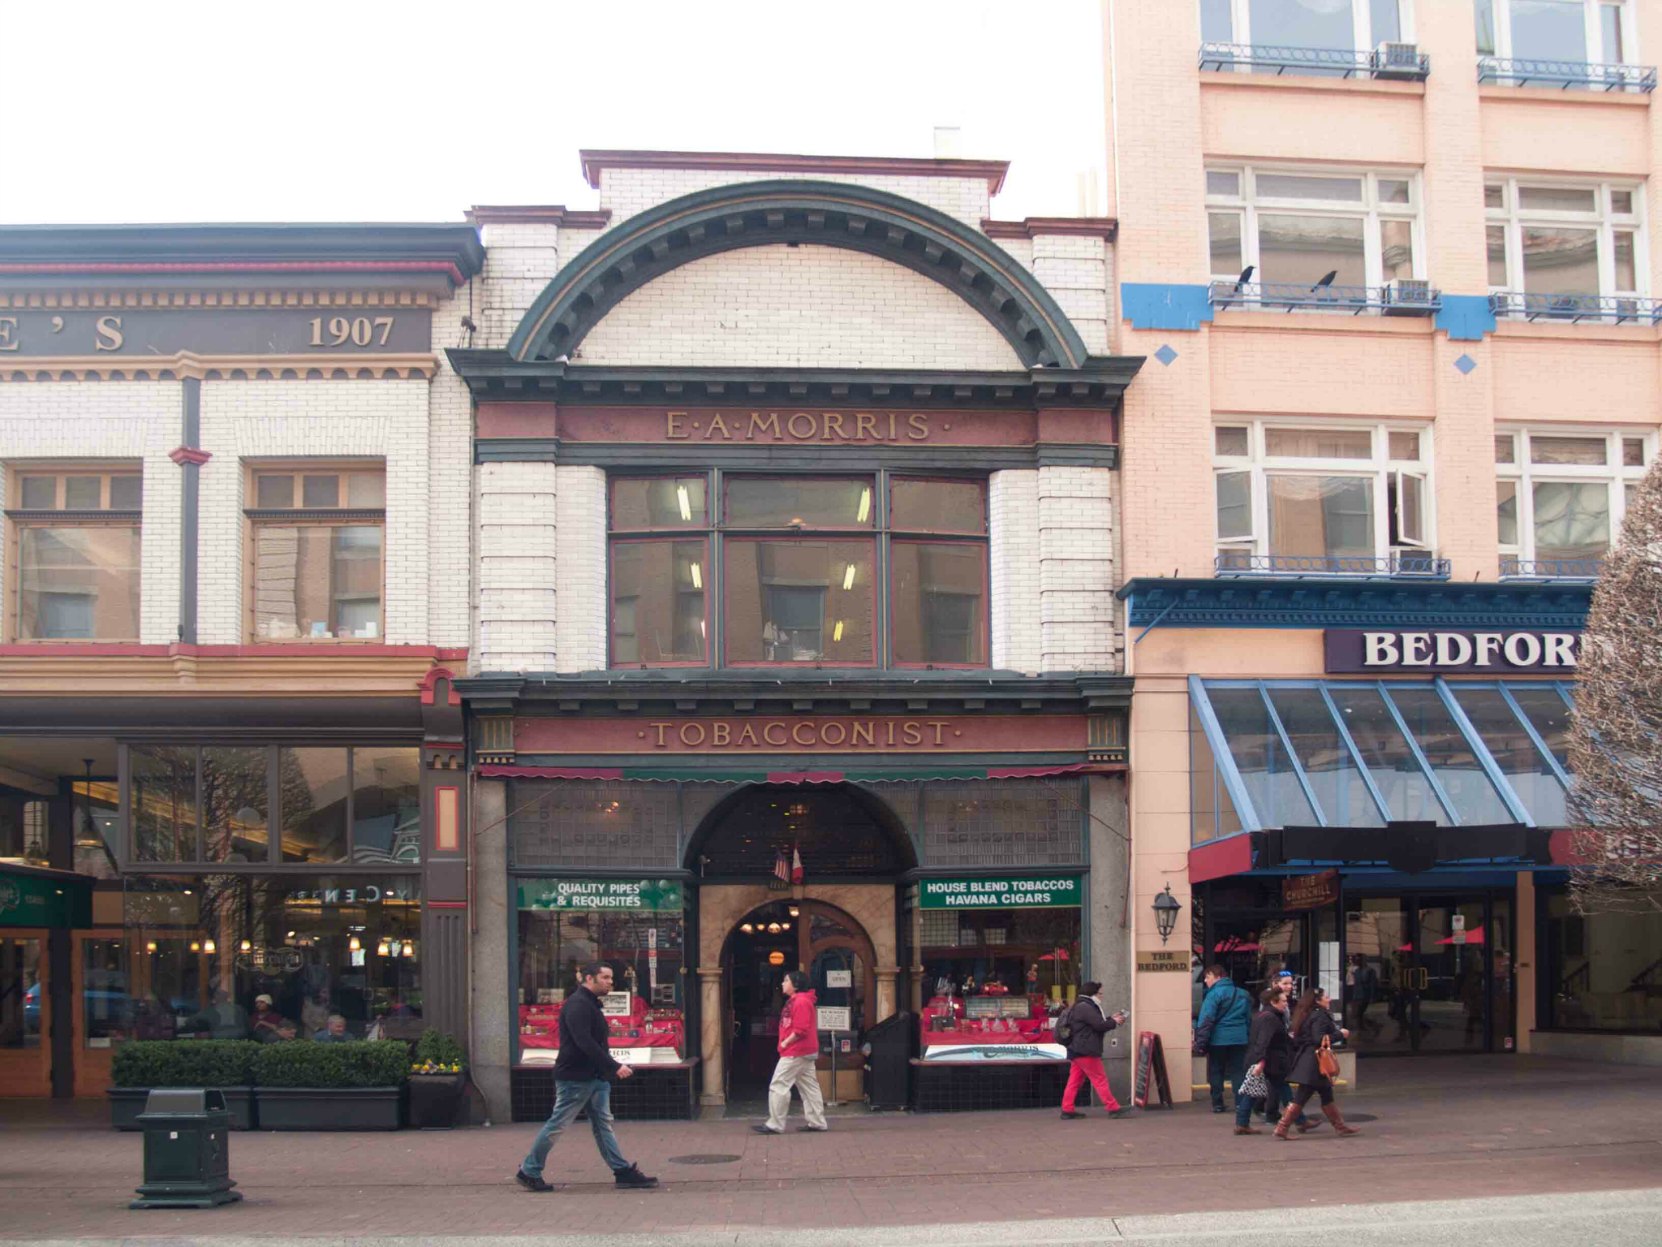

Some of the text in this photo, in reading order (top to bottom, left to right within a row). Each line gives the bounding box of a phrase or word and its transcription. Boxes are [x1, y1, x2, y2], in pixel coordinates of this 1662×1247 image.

[308, 316, 395, 347] 1907
[1363, 632, 1586, 667] BEDFOR
[651, 721, 950, 747] TOBACCONIST
[558, 883, 640, 895] QUALITY PIPES
[927, 880, 1074, 893] HOUSE BLEND TOBACCOS
[557, 895, 641, 908] & REQUISITES
[945, 893, 1051, 905] HAVANA CIGARS
[1151, 952, 1174, 961] THE
[1137, 962, 1187, 971] BEDFORD
